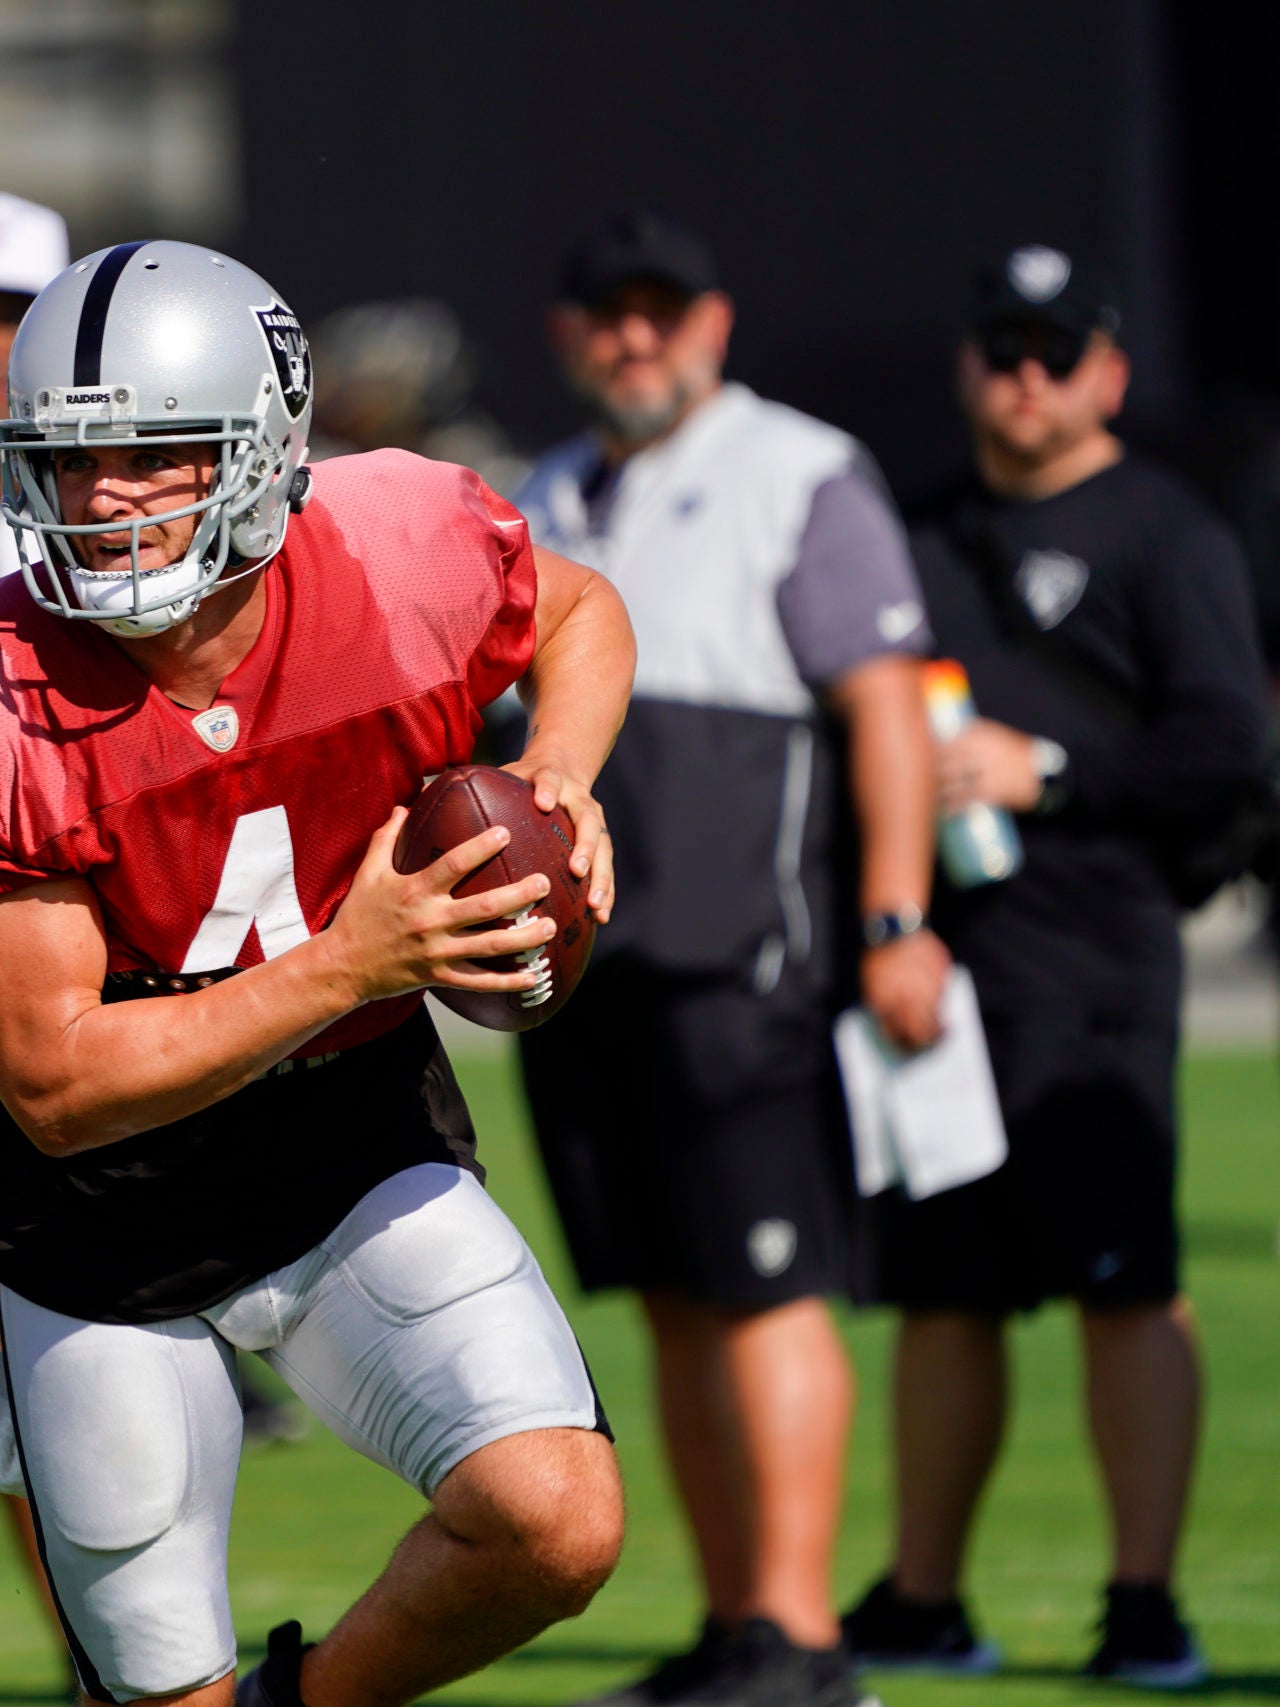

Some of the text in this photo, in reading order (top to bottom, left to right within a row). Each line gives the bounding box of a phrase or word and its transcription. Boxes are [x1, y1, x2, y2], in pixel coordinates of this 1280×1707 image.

[263, 314, 301, 329] RAIDER
[66, 393, 110, 405] RAIDERS
[179, 804, 312, 974] 4
